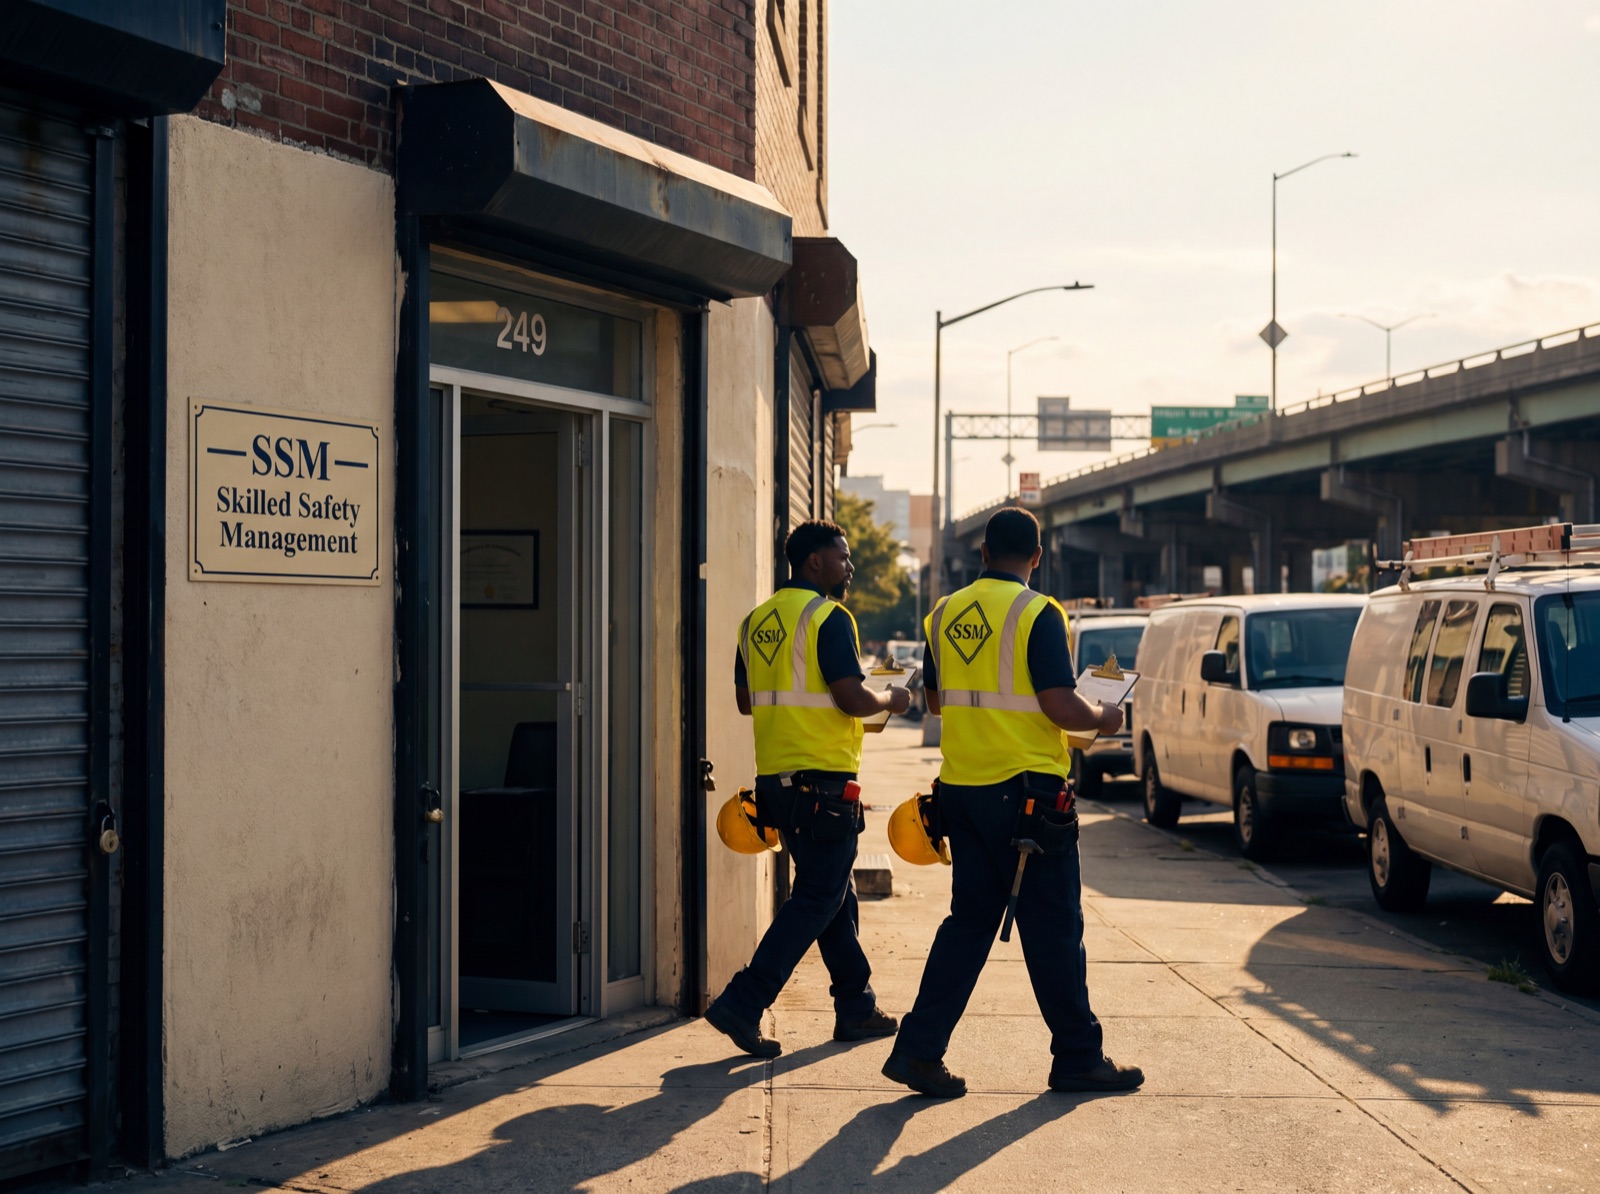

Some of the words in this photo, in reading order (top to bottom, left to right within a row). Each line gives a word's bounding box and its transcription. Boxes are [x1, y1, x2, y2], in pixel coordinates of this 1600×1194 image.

[496, 306, 546, 356] 249
[252, 434, 331, 481] SSM
[217, 486, 291, 517] Skilled
[298, 492, 361, 528] Safety
[219, 521, 358, 558] Management
[756, 629, 780, 644] SSM
[952, 623, 984, 640] SSM
